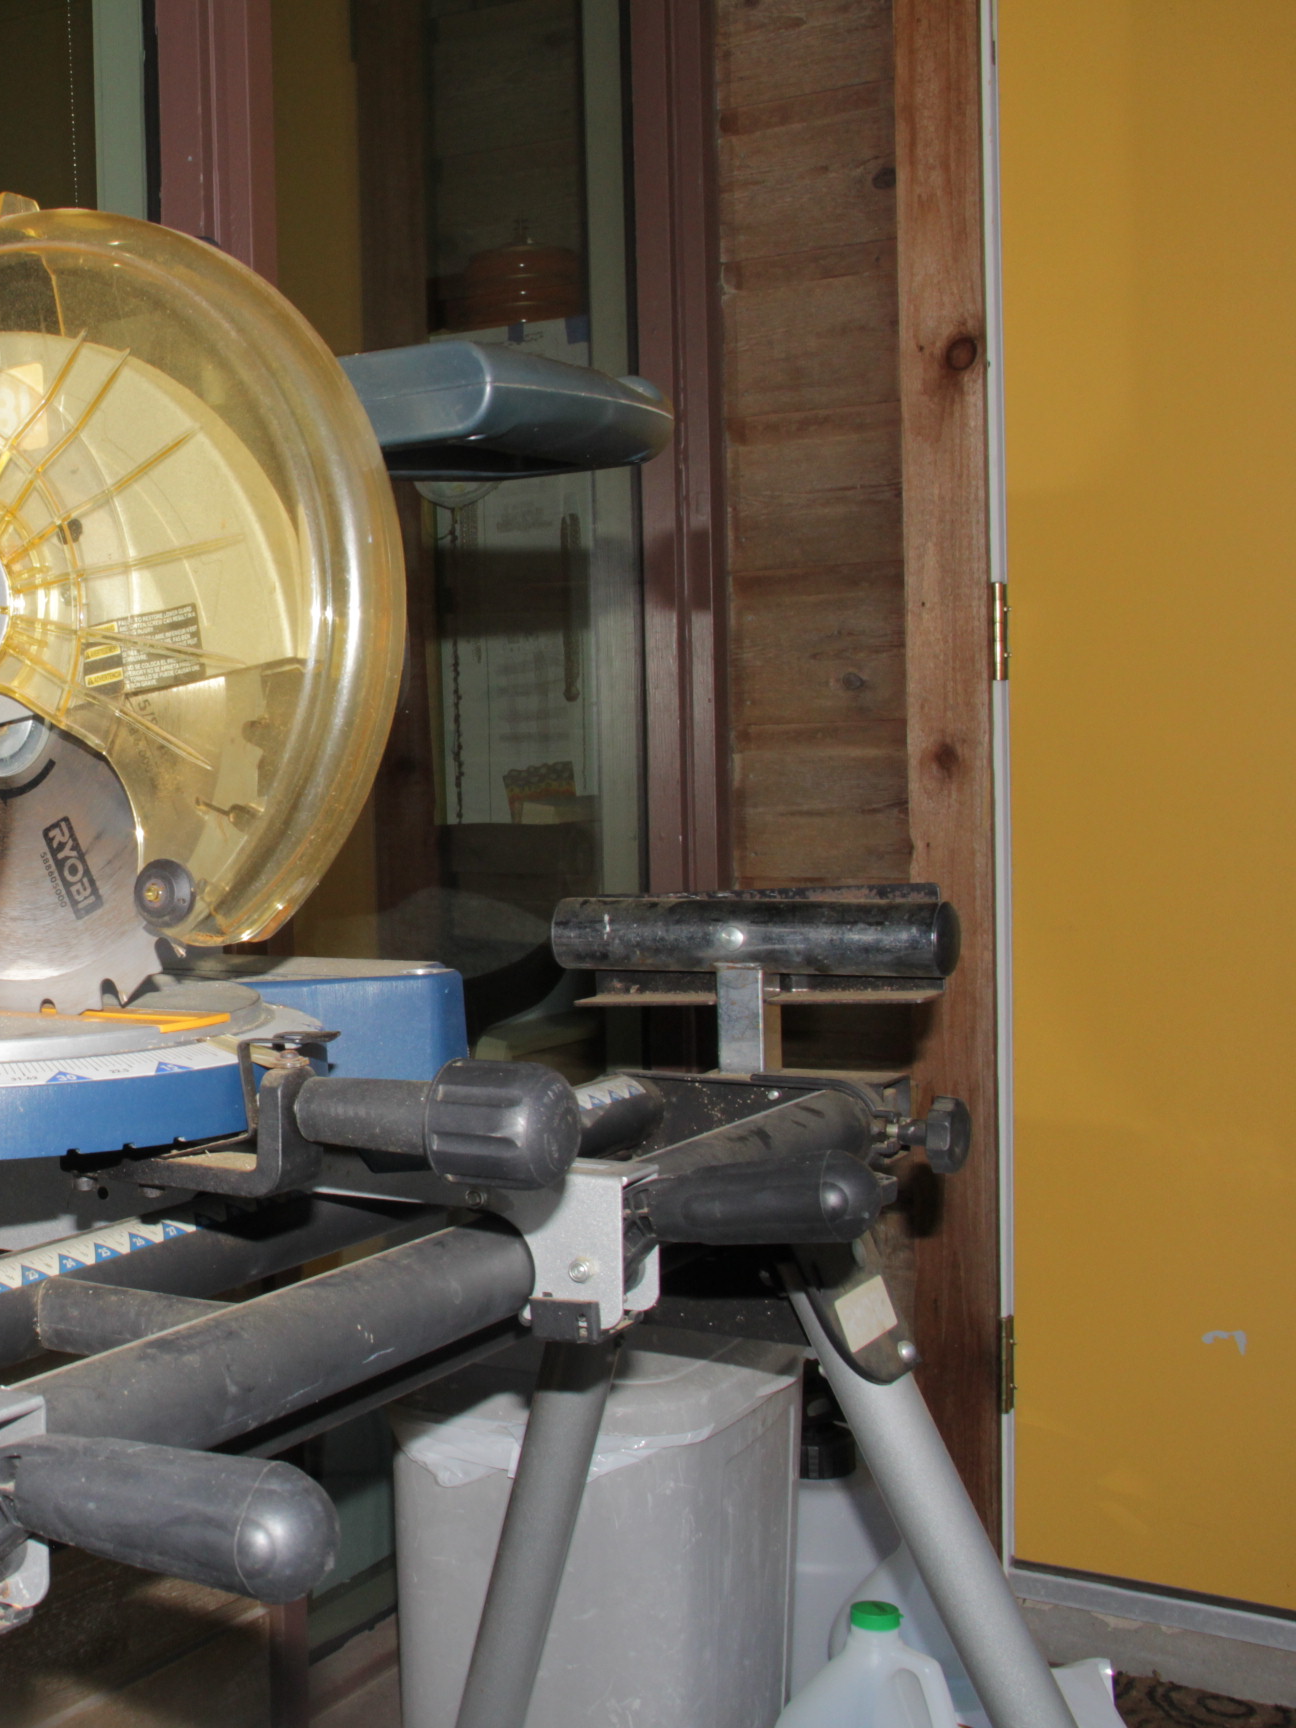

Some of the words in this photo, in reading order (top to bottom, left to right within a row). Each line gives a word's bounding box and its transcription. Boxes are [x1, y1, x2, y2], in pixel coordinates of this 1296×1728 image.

[48, 820, 97, 909] RYOBI
[56, 1073, 77, 1082] 30
[25, 1269, 39, 1281] 23
[62, 1258, 76, 1268] 24
[98, 1247, 111, 1257] 25
[132, 1236, 145, 1246] 26
[165, 1225, 177, 1236] 27
